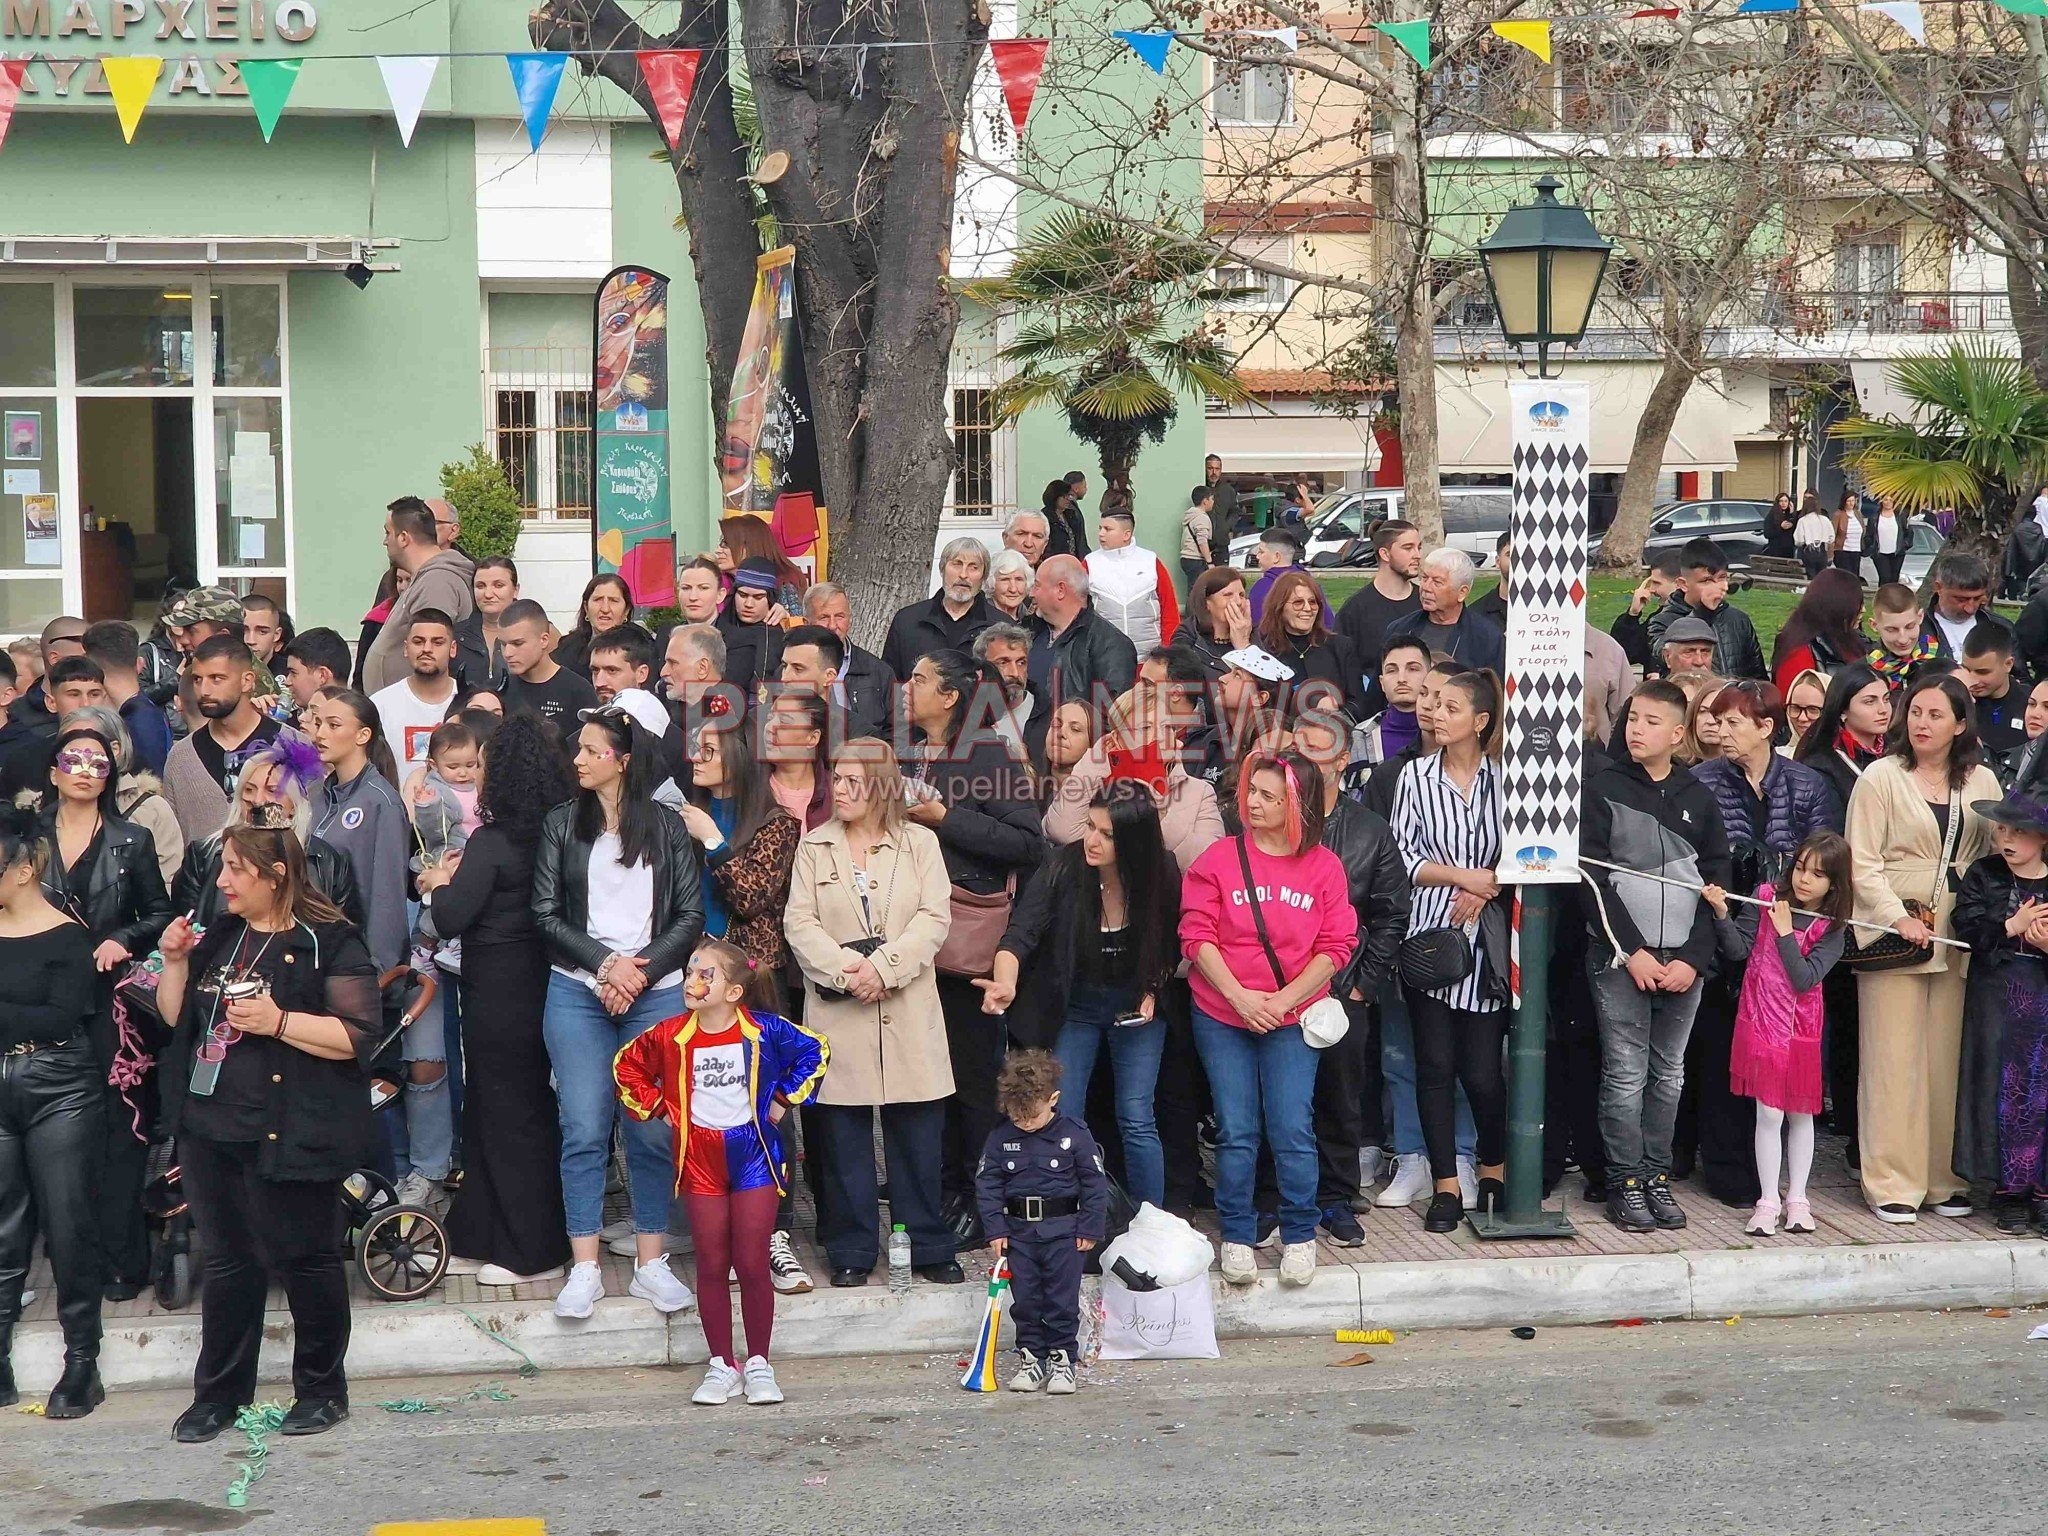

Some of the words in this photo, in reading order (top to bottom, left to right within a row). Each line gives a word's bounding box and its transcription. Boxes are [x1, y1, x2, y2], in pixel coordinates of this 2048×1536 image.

[1529, 613, 1559, 625] Όλη
[1517, 630, 1526, 638] η
[1533, 627, 1570, 639] πόλη
[1530, 643, 1557, 652] μια
[1517, 655, 1568, 667] γιορτή
[1279, 885, 1314, 912] MOM
[1003, 1143, 1021, 1151] POLICE
[1121, 1313, 1191, 1331] Princess
